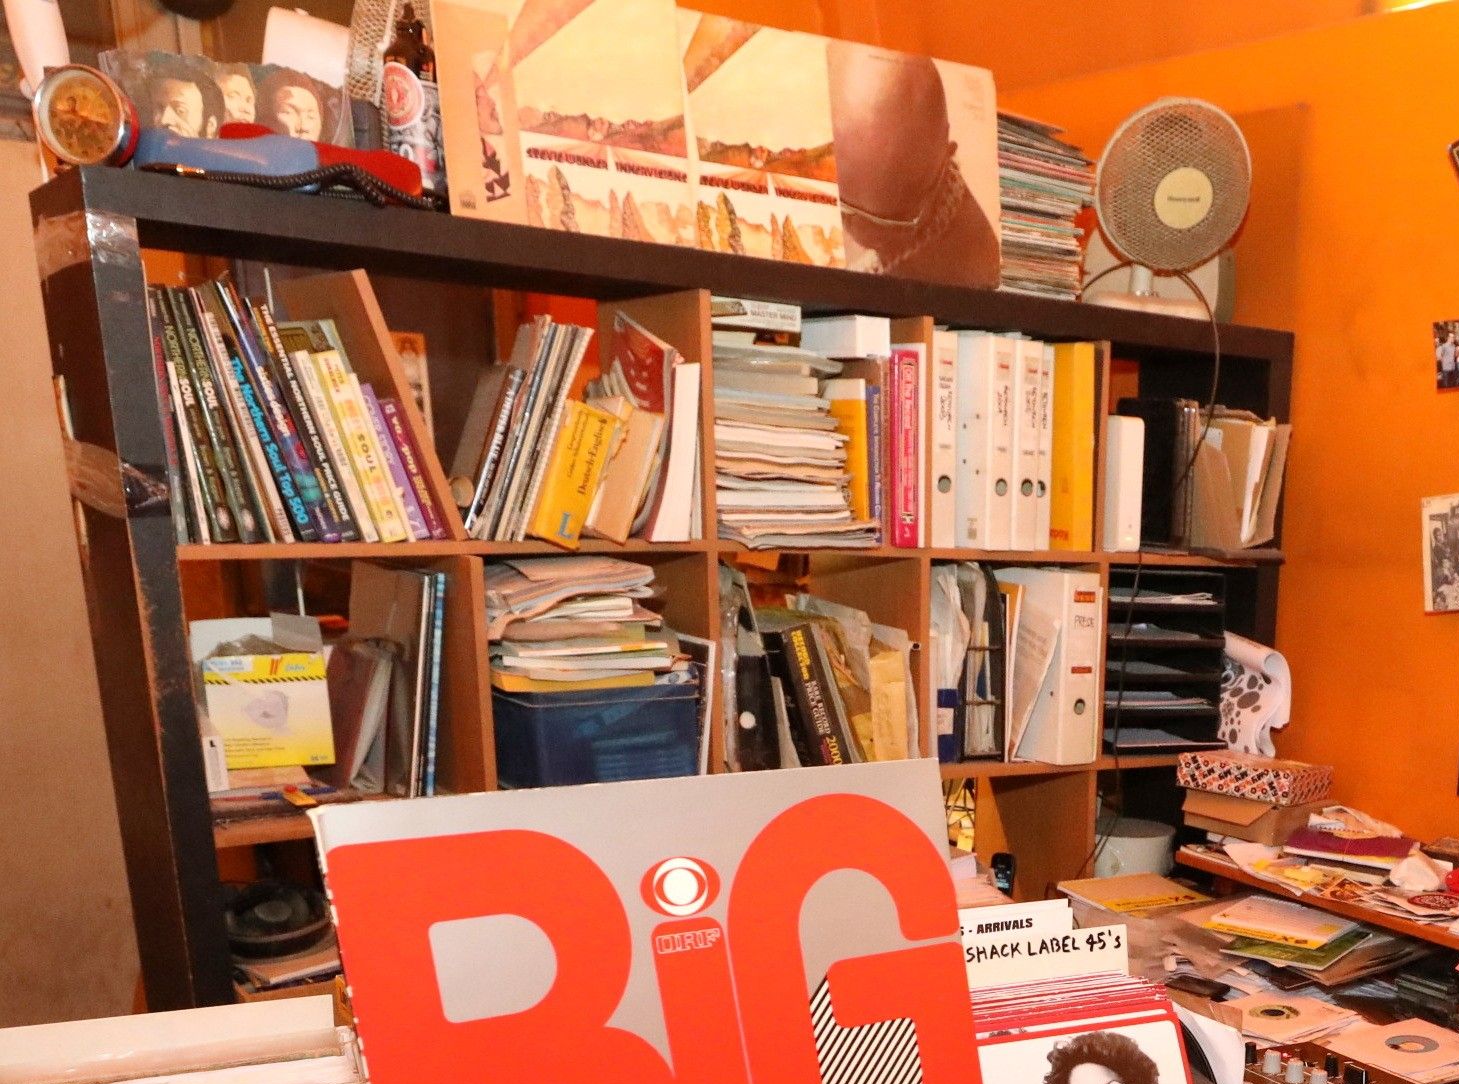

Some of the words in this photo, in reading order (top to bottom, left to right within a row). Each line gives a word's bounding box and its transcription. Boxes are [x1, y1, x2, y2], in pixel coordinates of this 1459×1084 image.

[268, 325, 295, 379] ESSENTIAL
[289, 379, 314, 440] NORTHERN
[240, 382, 271, 443] Northern
[266, 442, 288, 476] Soul
[289, 496, 309, 525] 500
[655, 928, 722, 955] ORF
[976, 917, 1033, 936] ARRIVALS
[965, 943, 1022, 963] SHACK
[1027, 936, 1081, 957] LABEL
[1085, 931, 1122, 952] 45's
